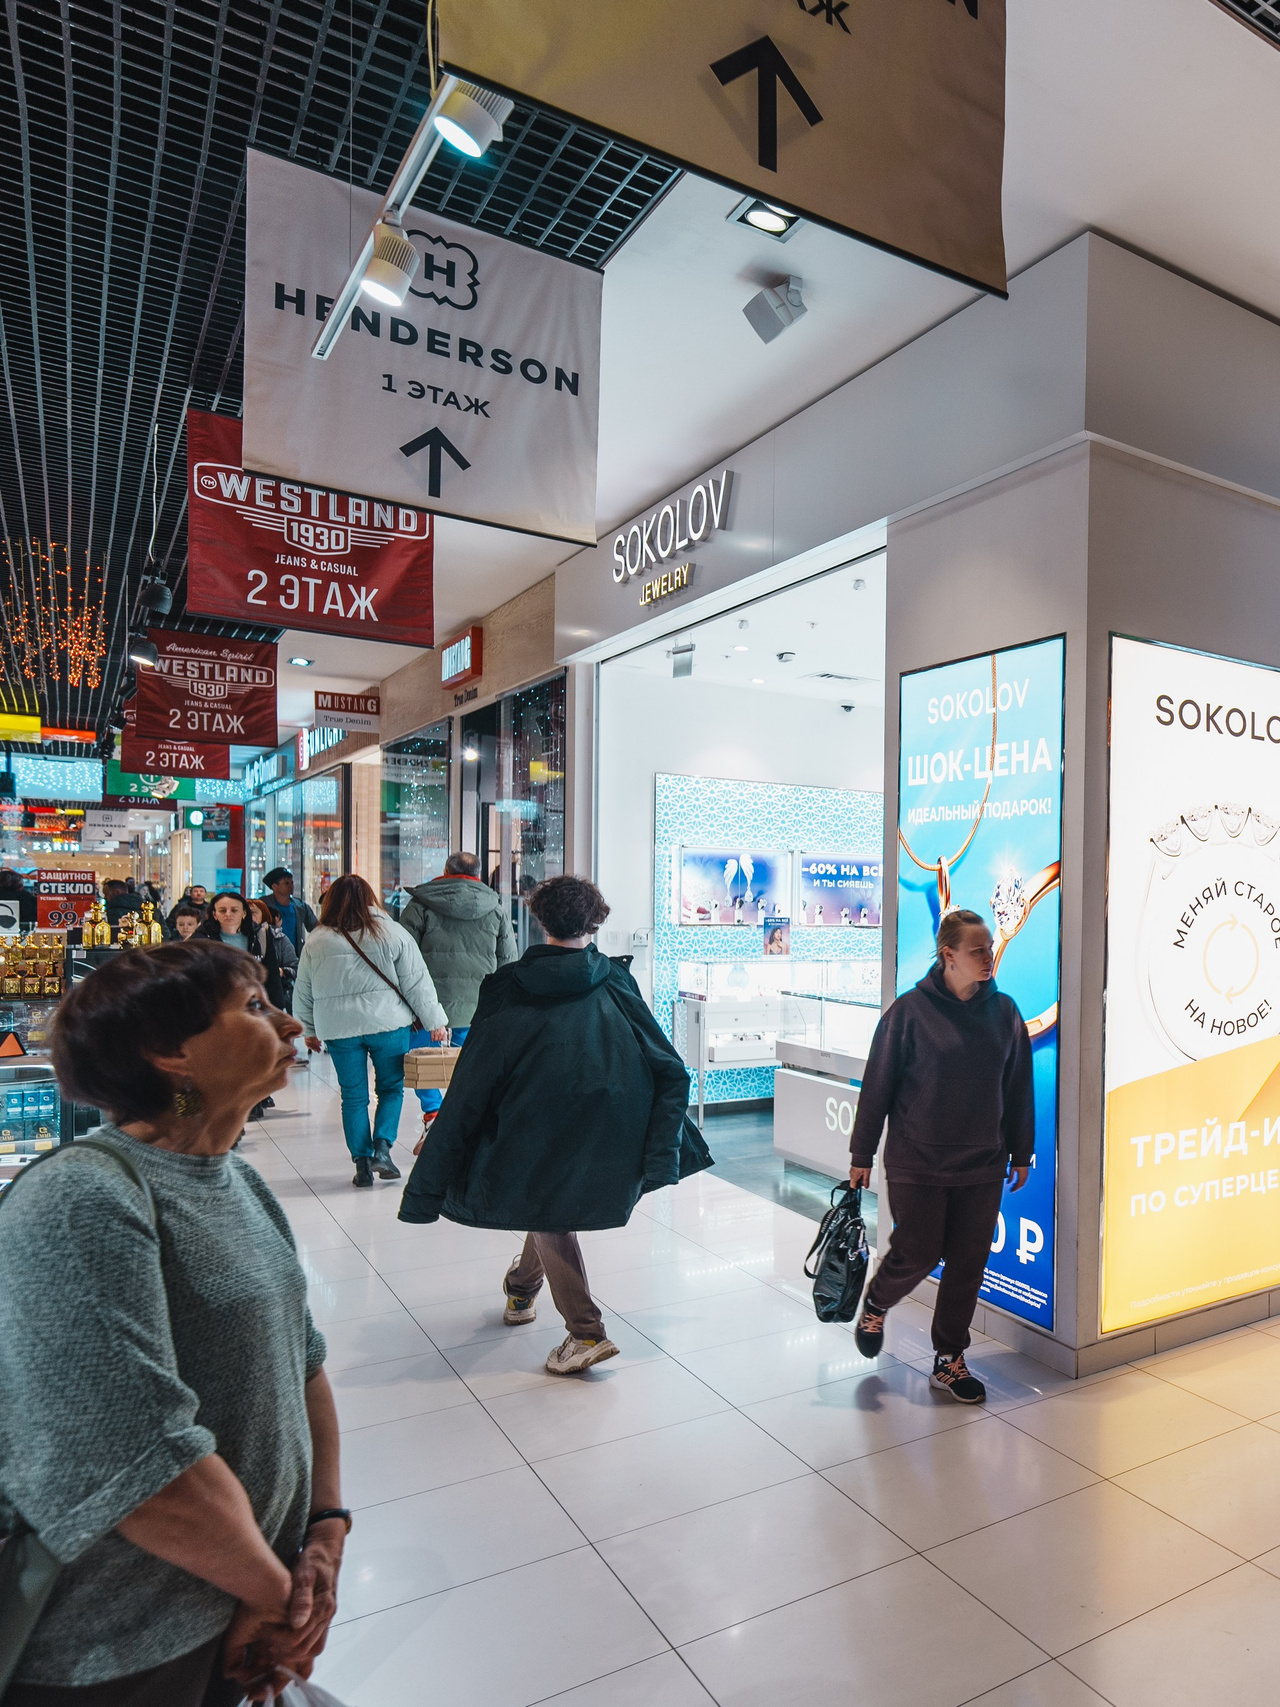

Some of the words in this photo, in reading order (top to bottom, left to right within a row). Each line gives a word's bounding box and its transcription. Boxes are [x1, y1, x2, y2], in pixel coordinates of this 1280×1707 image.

[424, 252, 455, 286] H
[275, 281, 580, 396] HENDERSON
[382, 374, 395, 392] 1
[407, 380, 491, 418] ЭТАЖ
[217, 471, 418, 532] WESTLAND
[290, 522, 345, 550] 1930
[612, 470, 733, 583] SOKOLOV
[275, 554, 307, 568] JEANS
[310, 559, 319, 570] &
[320, 561, 359, 576] CASUAL
[247, 570, 268, 605] 2
[279, 574, 379, 622] ЭТАЖ
[639, 563, 690, 606] JEWELRY
[166, 643, 217, 658] American
[220, 648, 254, 662] Spirit
[154, 658, 268, 685] WESTLAND
[192, 682, 225, 697] 1930
[318, 694, 377, 712] MUSTANG
[927, 679, 1029, 724] SOKOLOV
[184, 700, 202, 708] JEANS
[210, 701, 232, 710] CASUAL
[169, 709, 181, 729] 2
[187, 711, 245, 735] ЭТАЖ
[345, 716, 372, 725] Denim
[146, 751, 155, 767] 2
[159, 752, 205, 770] ЭТАЖ
[907, 738, 1052, 786] ШОК-ЦЕНА
[130, 783, 138, 792] 2
[907, 800, 982, 825] ИДЕАЛЬНЫЙ
[984, 798, 1052, 820] ПОДАРОК!
[33, 841, 80, 852] ZARIN
[40, 871, 93, 881] ЗАЩИТНОЕ
[813, 879, 820, 887] И
[822, 880, 835, 888] ТЫ
[837, 880, 874, 889] СИЯЕШЬ
[841, 865, 860, 876] НА
[39, 883, 93, 894] СТЕКЛО
[1173, 878, 1227, 949] МЕНЯЙ
[1184, 999, 1207, 1029] НА
[1210, 1001, 1273, 1036] НОВОЕ!
[1130, 1190, 1166, 1217] ПО
[1130, 1291, 1181, 1309] Подробности
[1181, 1281, 1217, 1298] уточняйте
